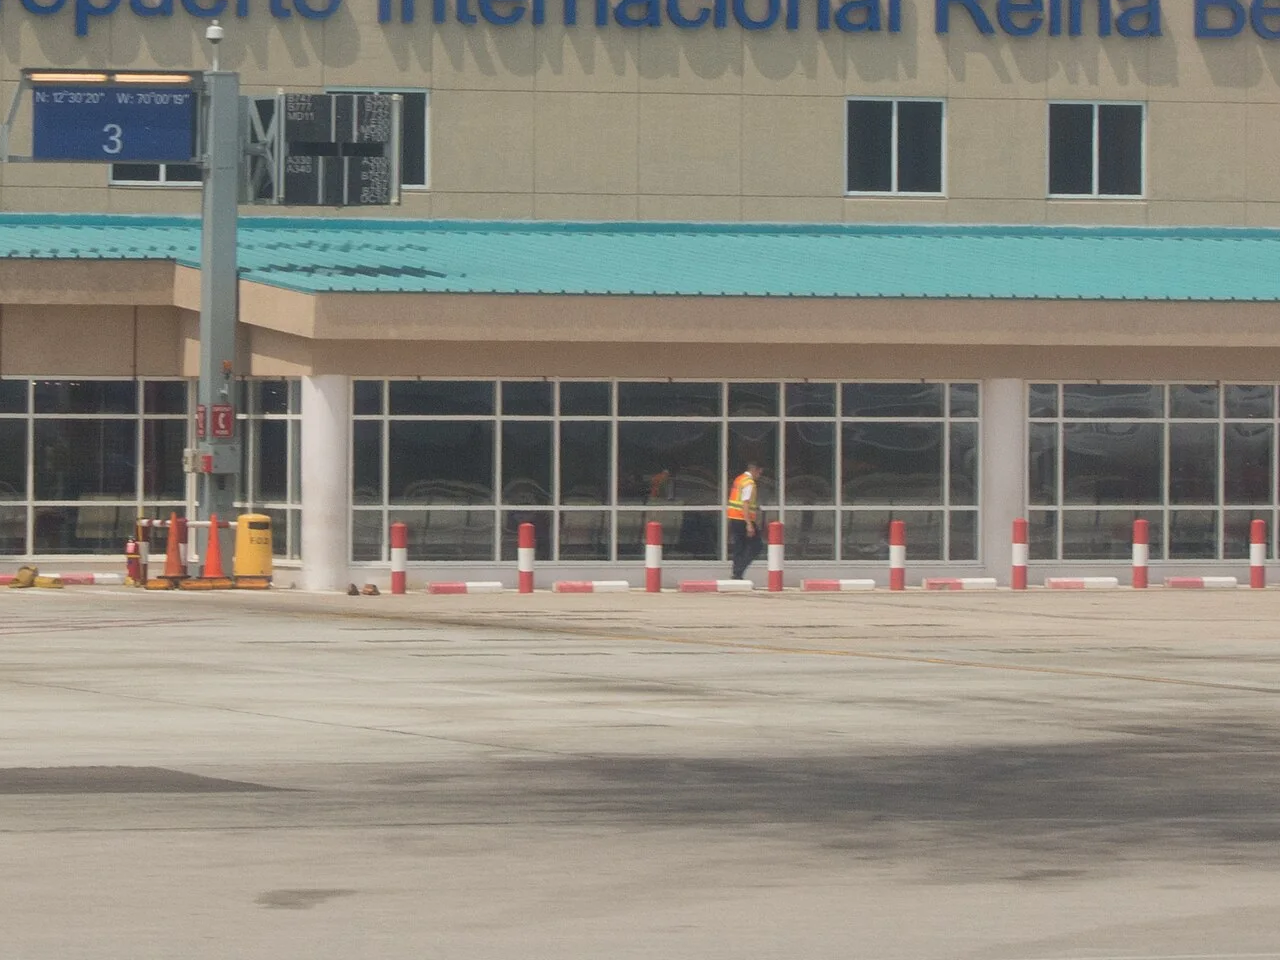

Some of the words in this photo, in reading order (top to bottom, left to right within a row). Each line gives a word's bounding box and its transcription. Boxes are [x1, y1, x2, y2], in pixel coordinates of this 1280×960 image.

[286, 102, 313, 112] B777
[286, 112, 315, 121] MD11
[102, 123, 124, 154] 3
